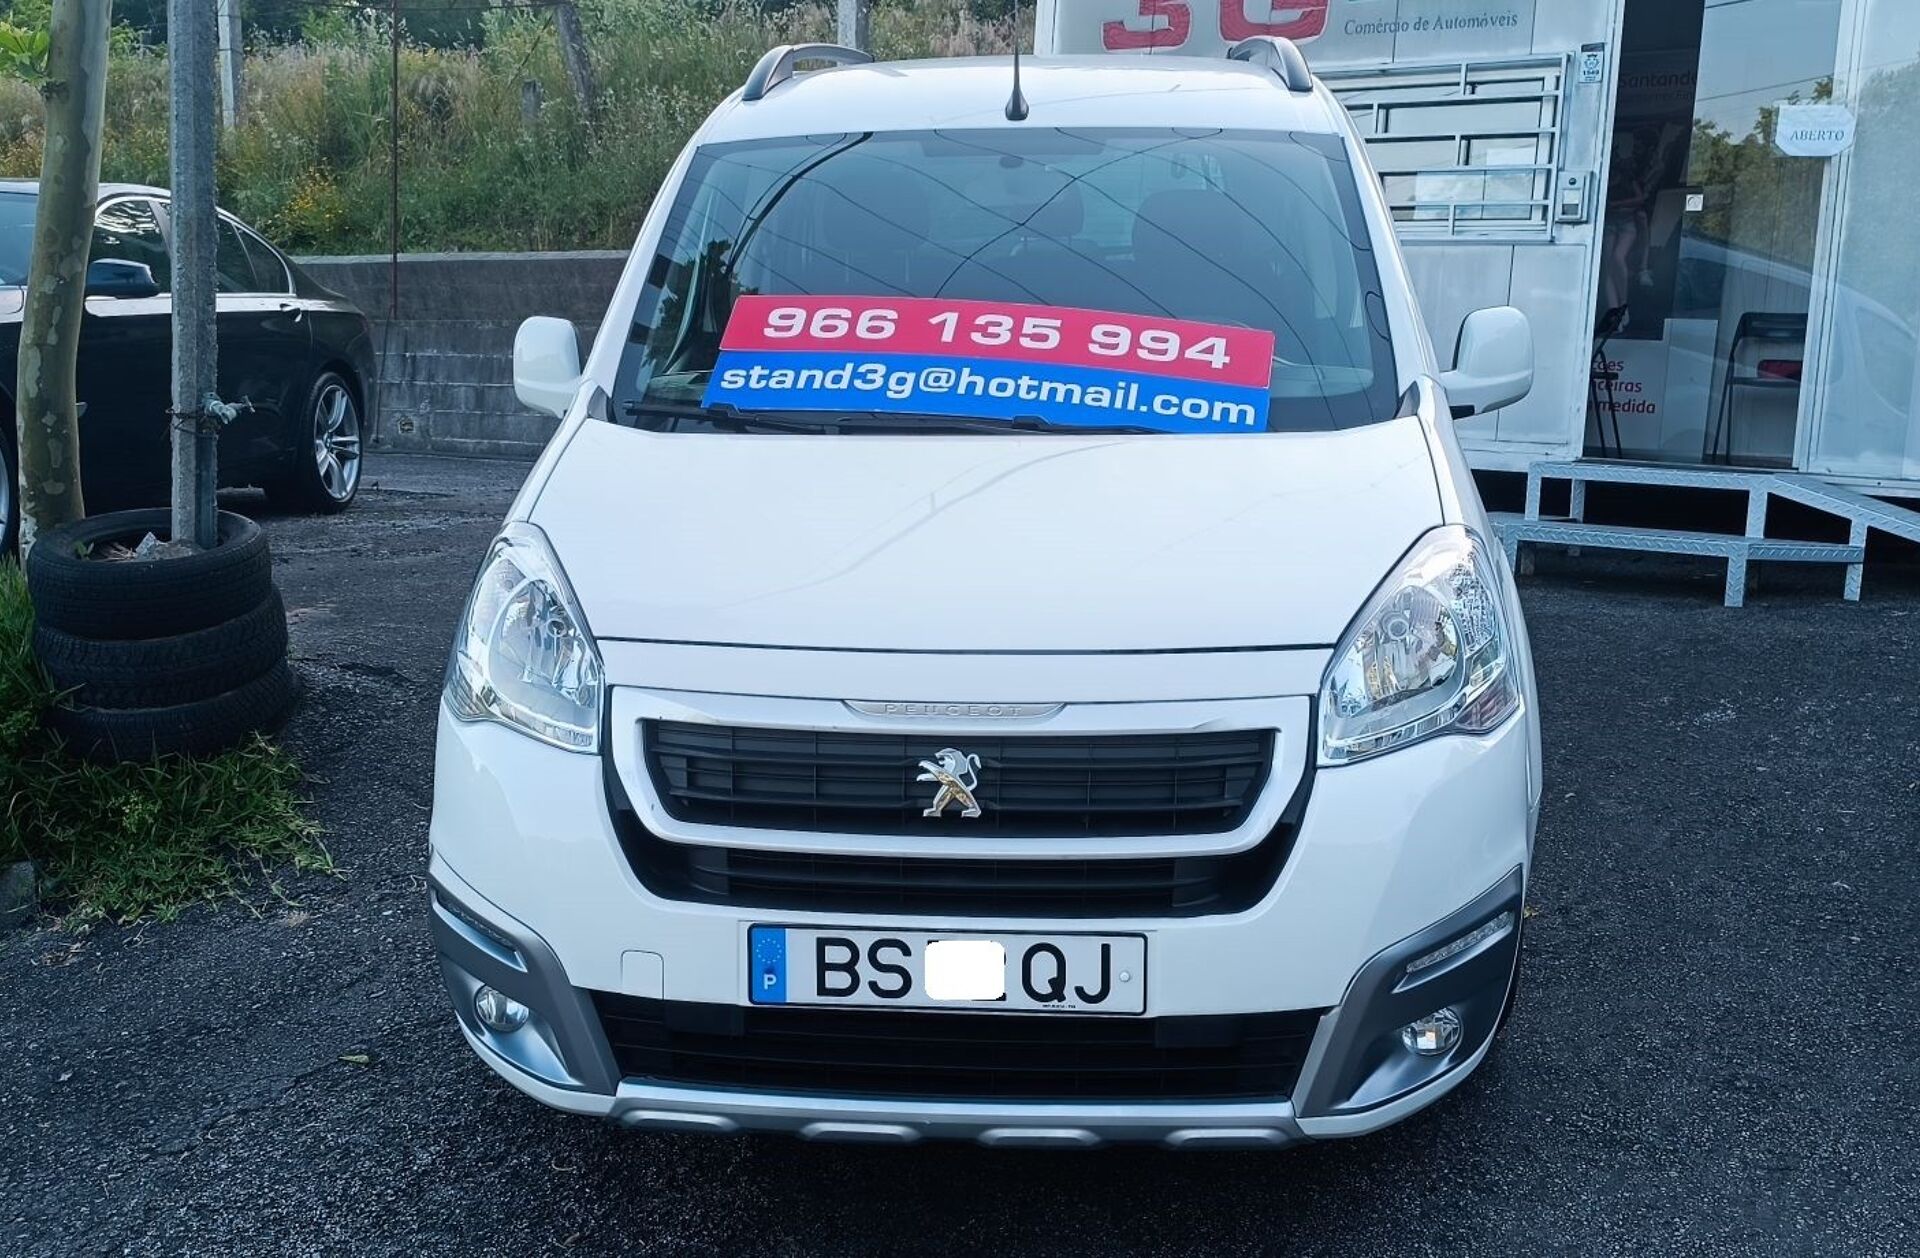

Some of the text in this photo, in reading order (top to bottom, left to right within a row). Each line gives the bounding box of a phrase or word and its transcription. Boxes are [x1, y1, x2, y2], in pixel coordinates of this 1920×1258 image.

[1344, 10, 1518, 36] Comércio de Automóveis
[1790, 129, 1845, 141] ABERTO
[763, 307, 1231, 369] 966 135 994
[720, 362, 1256, 426] stand3g@hotmail.com
[884, 703, 1023, 717] PEUGEOT
[763, 973, 777, 990] P
[816, 936, 912, 999] BS
[1021, 942, 1111, 1004] QJ
